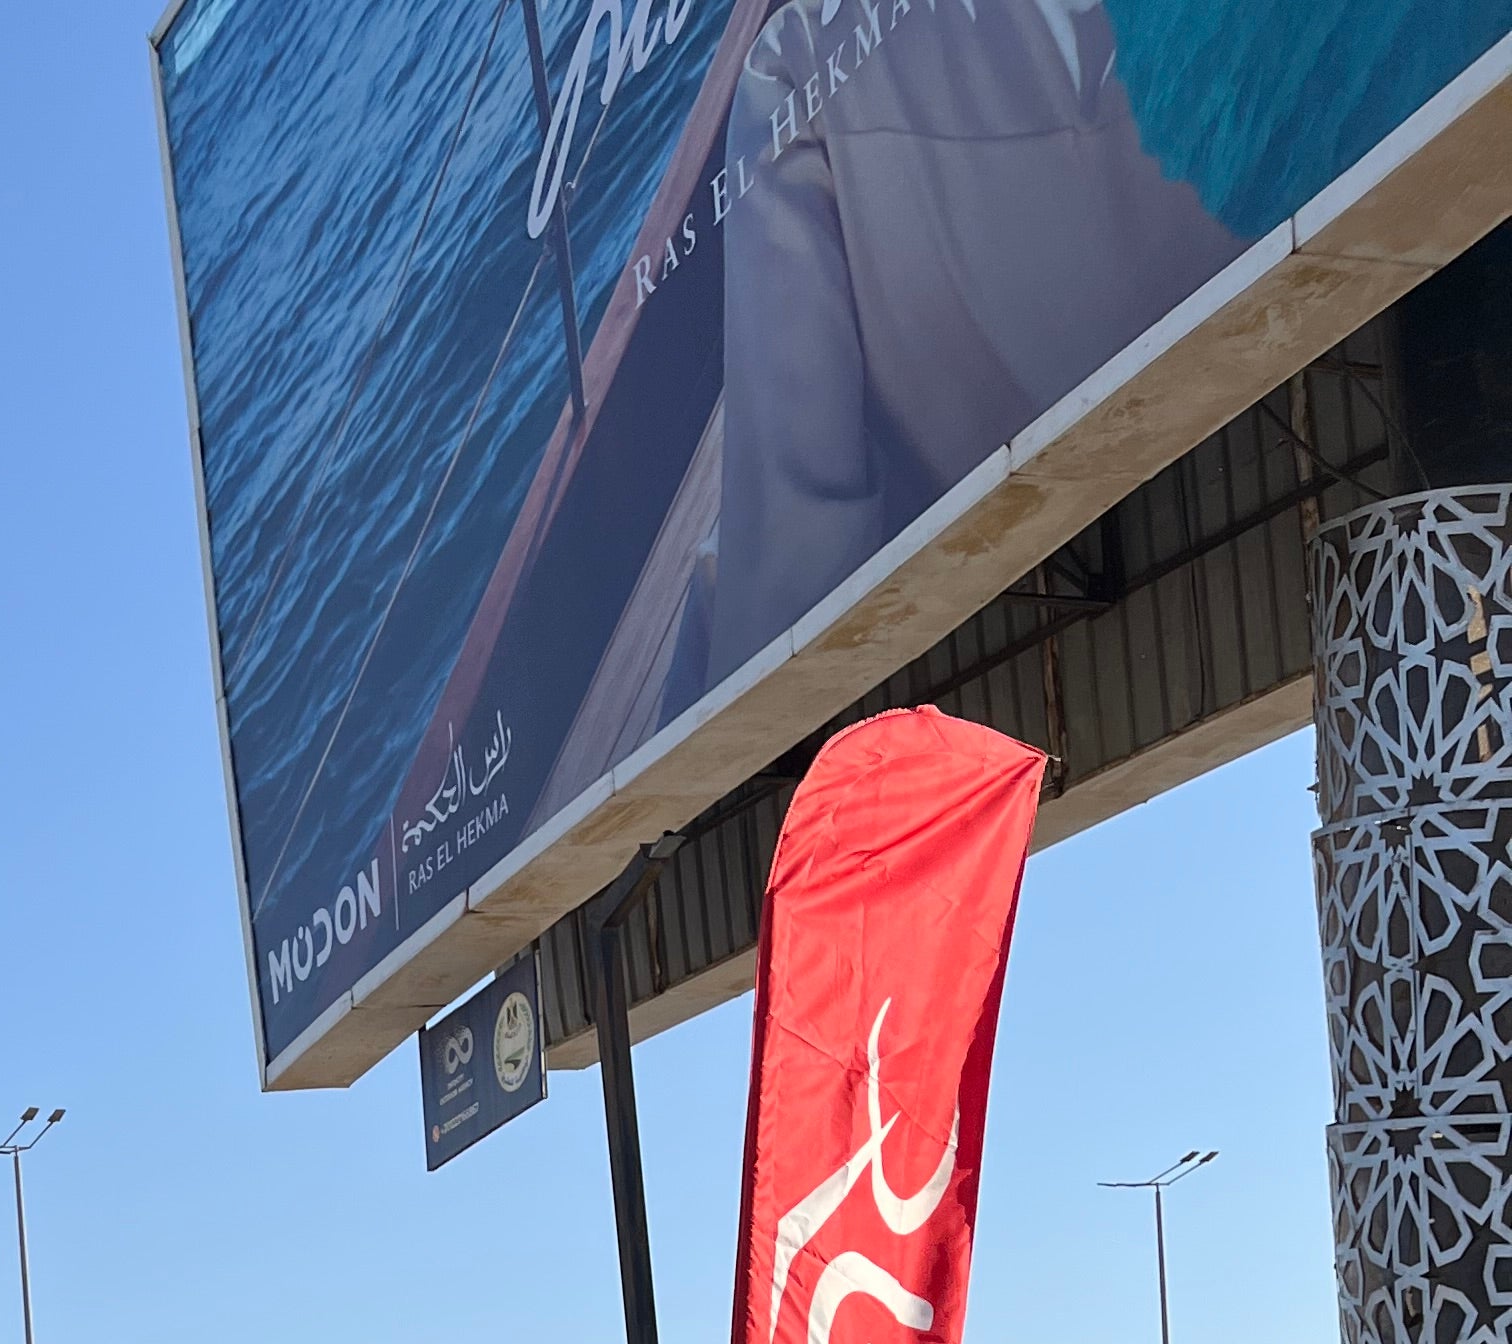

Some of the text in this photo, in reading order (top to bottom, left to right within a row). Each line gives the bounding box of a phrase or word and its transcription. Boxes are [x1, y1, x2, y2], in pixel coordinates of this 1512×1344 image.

[631, 0, 912, 309] RAS EL HEKMA
[408, 793, 509, 895] RAS EL HEKMA
